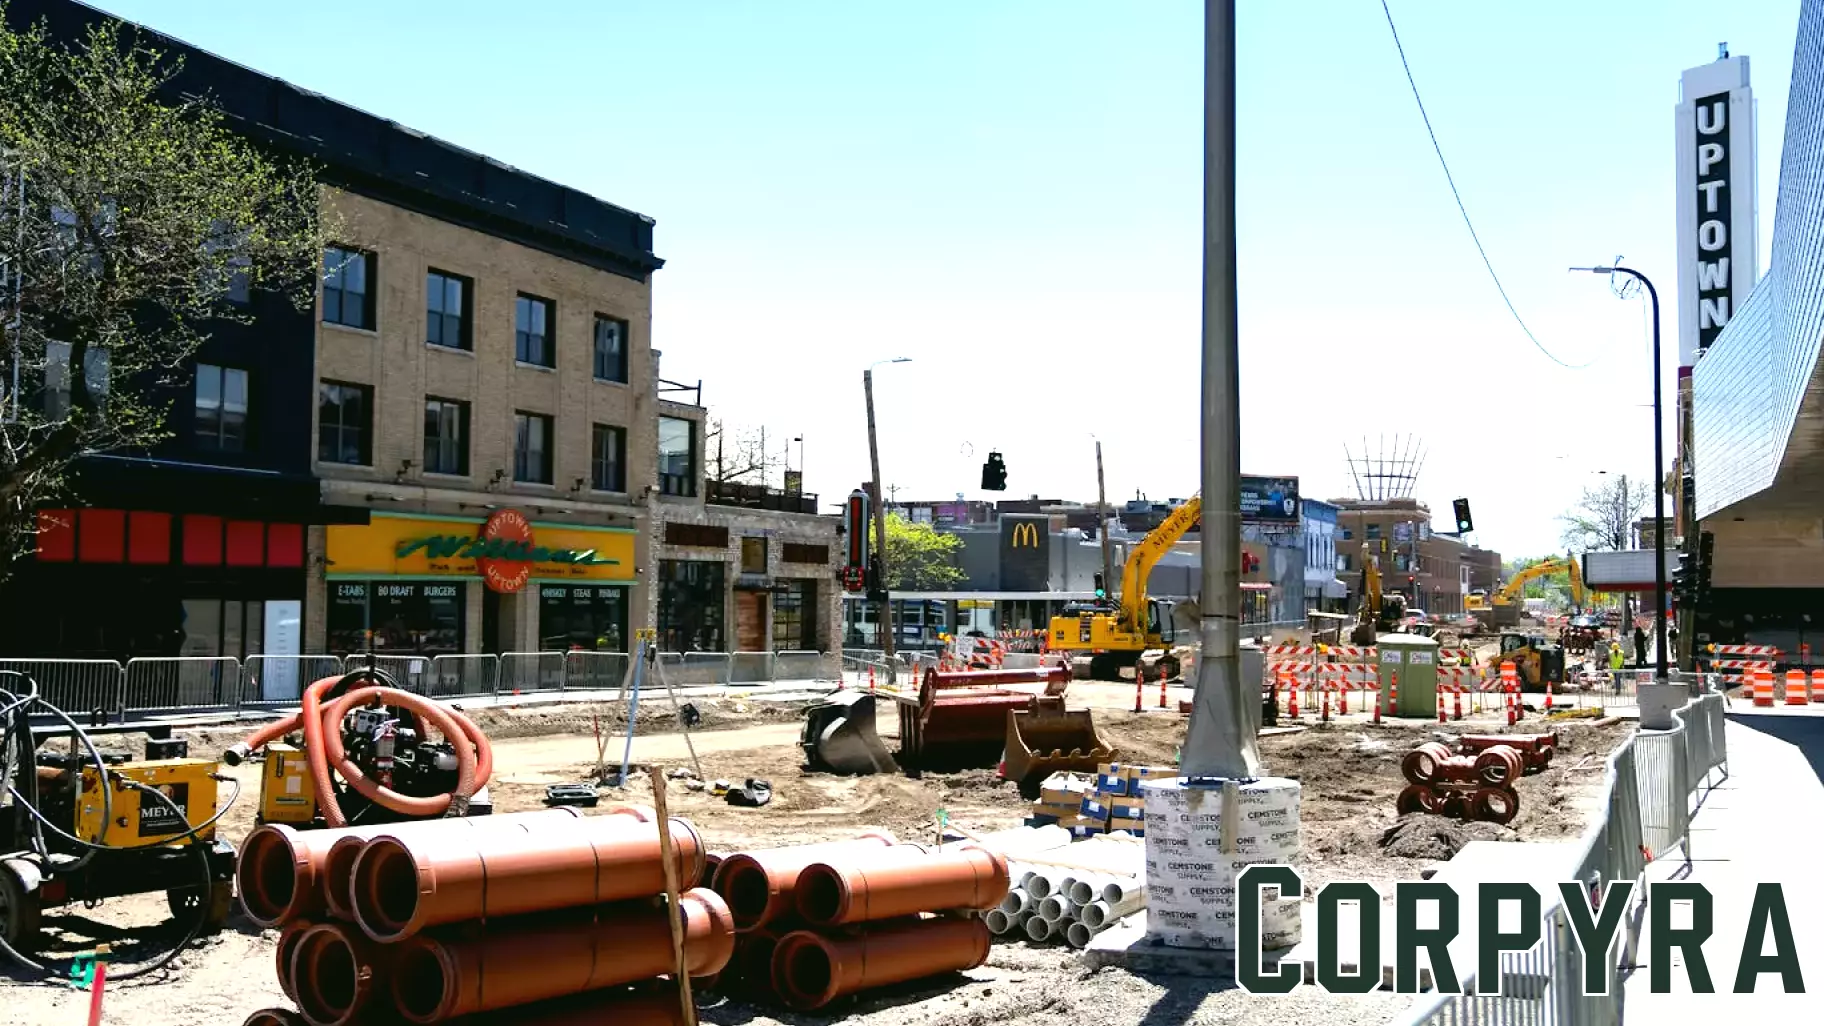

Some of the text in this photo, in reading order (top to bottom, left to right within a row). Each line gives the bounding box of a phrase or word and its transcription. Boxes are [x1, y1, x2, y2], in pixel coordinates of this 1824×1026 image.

[1697, 101, 1729, 329] UPTOWN
[489, 511, 530, 537] UPTOWN
[487, 564, 529, 590] UPTOWN
[390, 586, 414, 596] DRAFT
[424, 586, 456, 597] BURGERS
[141, 804, 186, 818] MEYR
[1168, 862, 1213, 870] CEMSTONE
